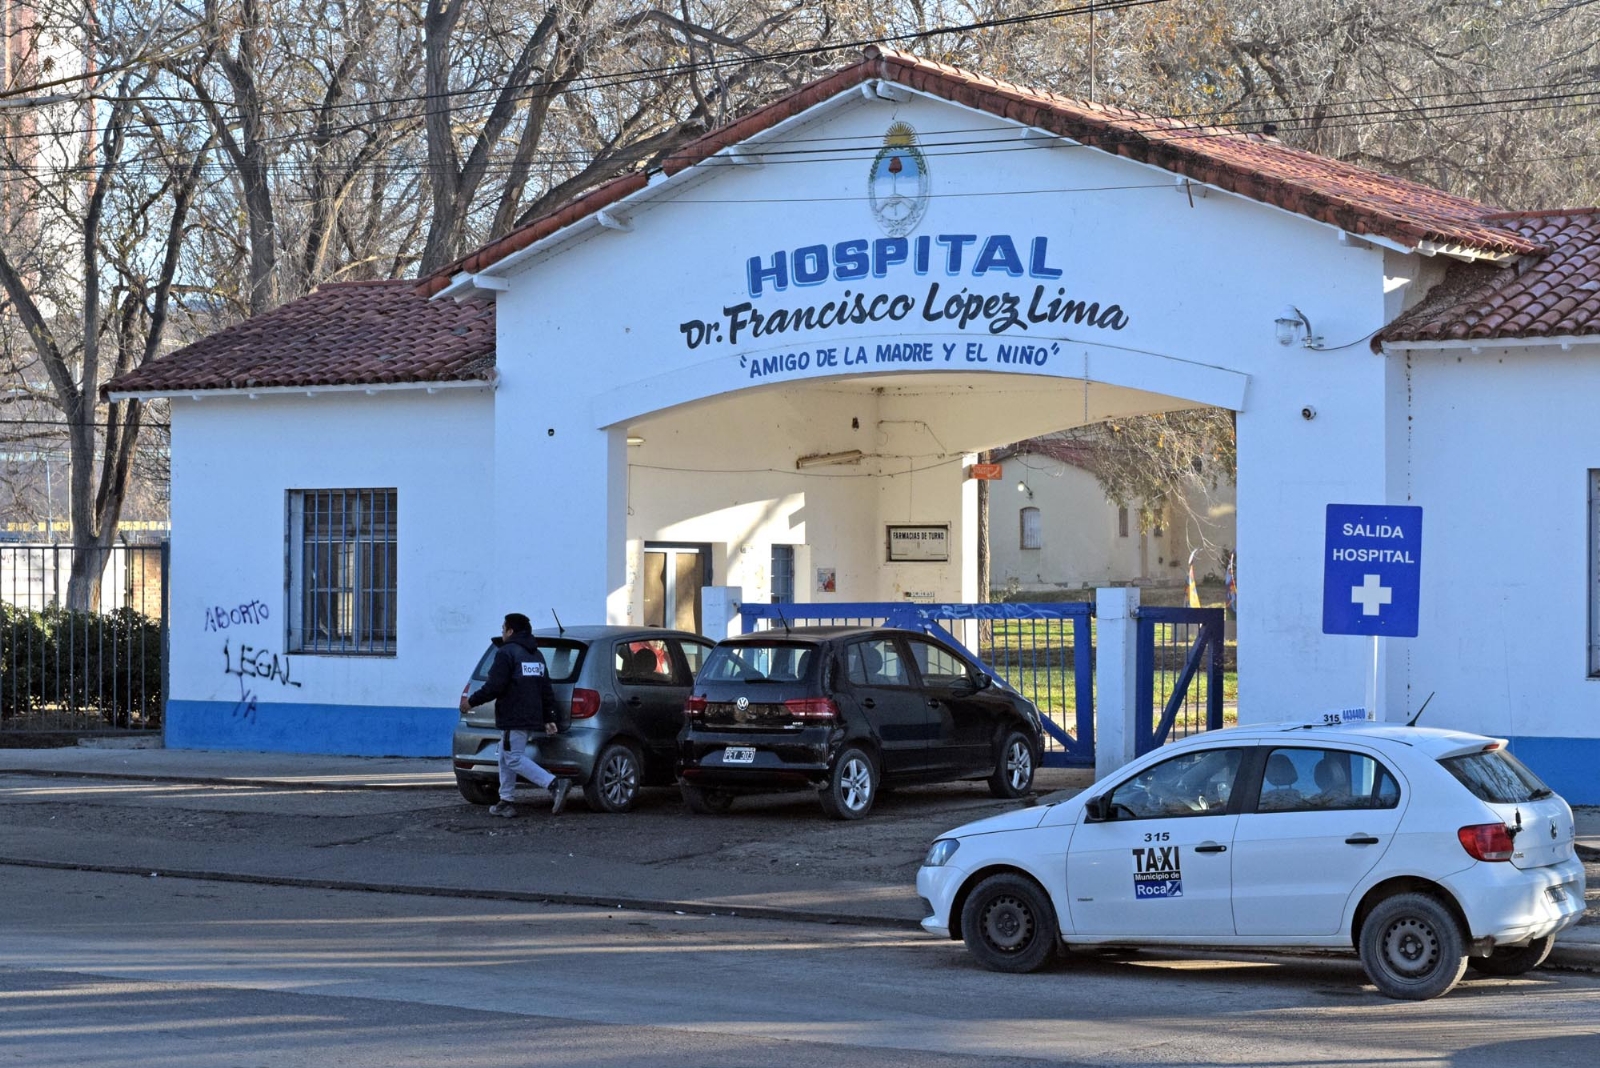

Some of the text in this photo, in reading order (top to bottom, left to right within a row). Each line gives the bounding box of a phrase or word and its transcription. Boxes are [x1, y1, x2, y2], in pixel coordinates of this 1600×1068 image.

[746, 235, 1063, 298] HOSPITAL
[680, 282, 1129, 349] Dr. Francisco López Lima
[816, 348, 838, 367] DE
[844, 346, 868, 365] LA
[875, 343, 933, 363] MADRE
[942, 343, 956, 361] Y
[966, 343, 988, 361] EL
[893, 532, 944, 540] FARMACIAS DE TURNO
[1342, 523, 1404, 539] SALIDA
[1332, 548, 1415, 564] HOSPITAL
[204, 599, 270, 632] ABORTO
[224, 638, 301, 687] LEGAL
[523, 664, 540, 675] Roca
[1323, 714, 1340, 722] 315
[1144, 832, 1170, 842] 315
[1132, 846, 1180, 872] TAXI
[1134, 872, 1169, 881] Municipio
[1136, 884, 1167, 895] Roca
